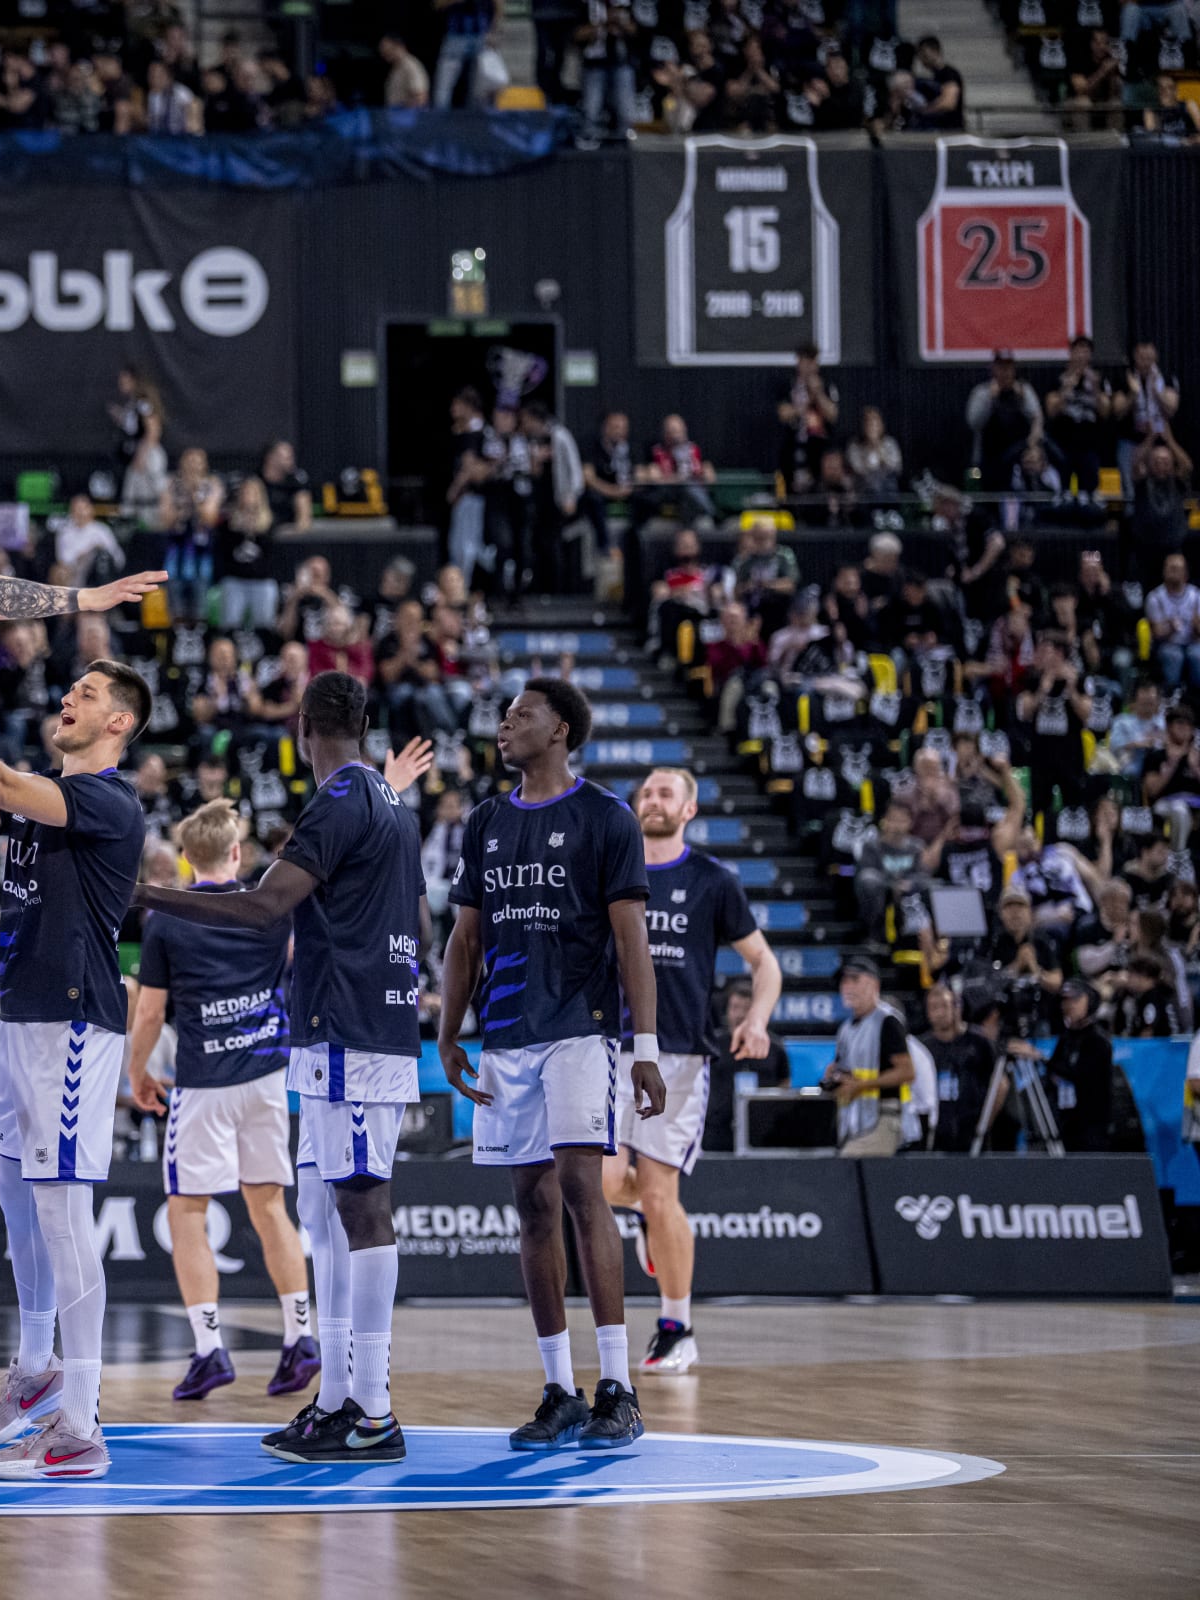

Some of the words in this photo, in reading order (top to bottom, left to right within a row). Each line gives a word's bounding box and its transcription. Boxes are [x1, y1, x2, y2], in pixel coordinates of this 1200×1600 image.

[968, 160, 1034, 187] TXIPI
[724, 206, 781, 273] 15
[957, 217, 1050, 289] 25
[485, 862, 566, 892] surne
[201, 988, 272, 1019] MEDRAN
[385, 989, 405, 1005] EL
[203, 1039, 225, 1054] EL
[958, 1194, 1143, 1239] hummel
